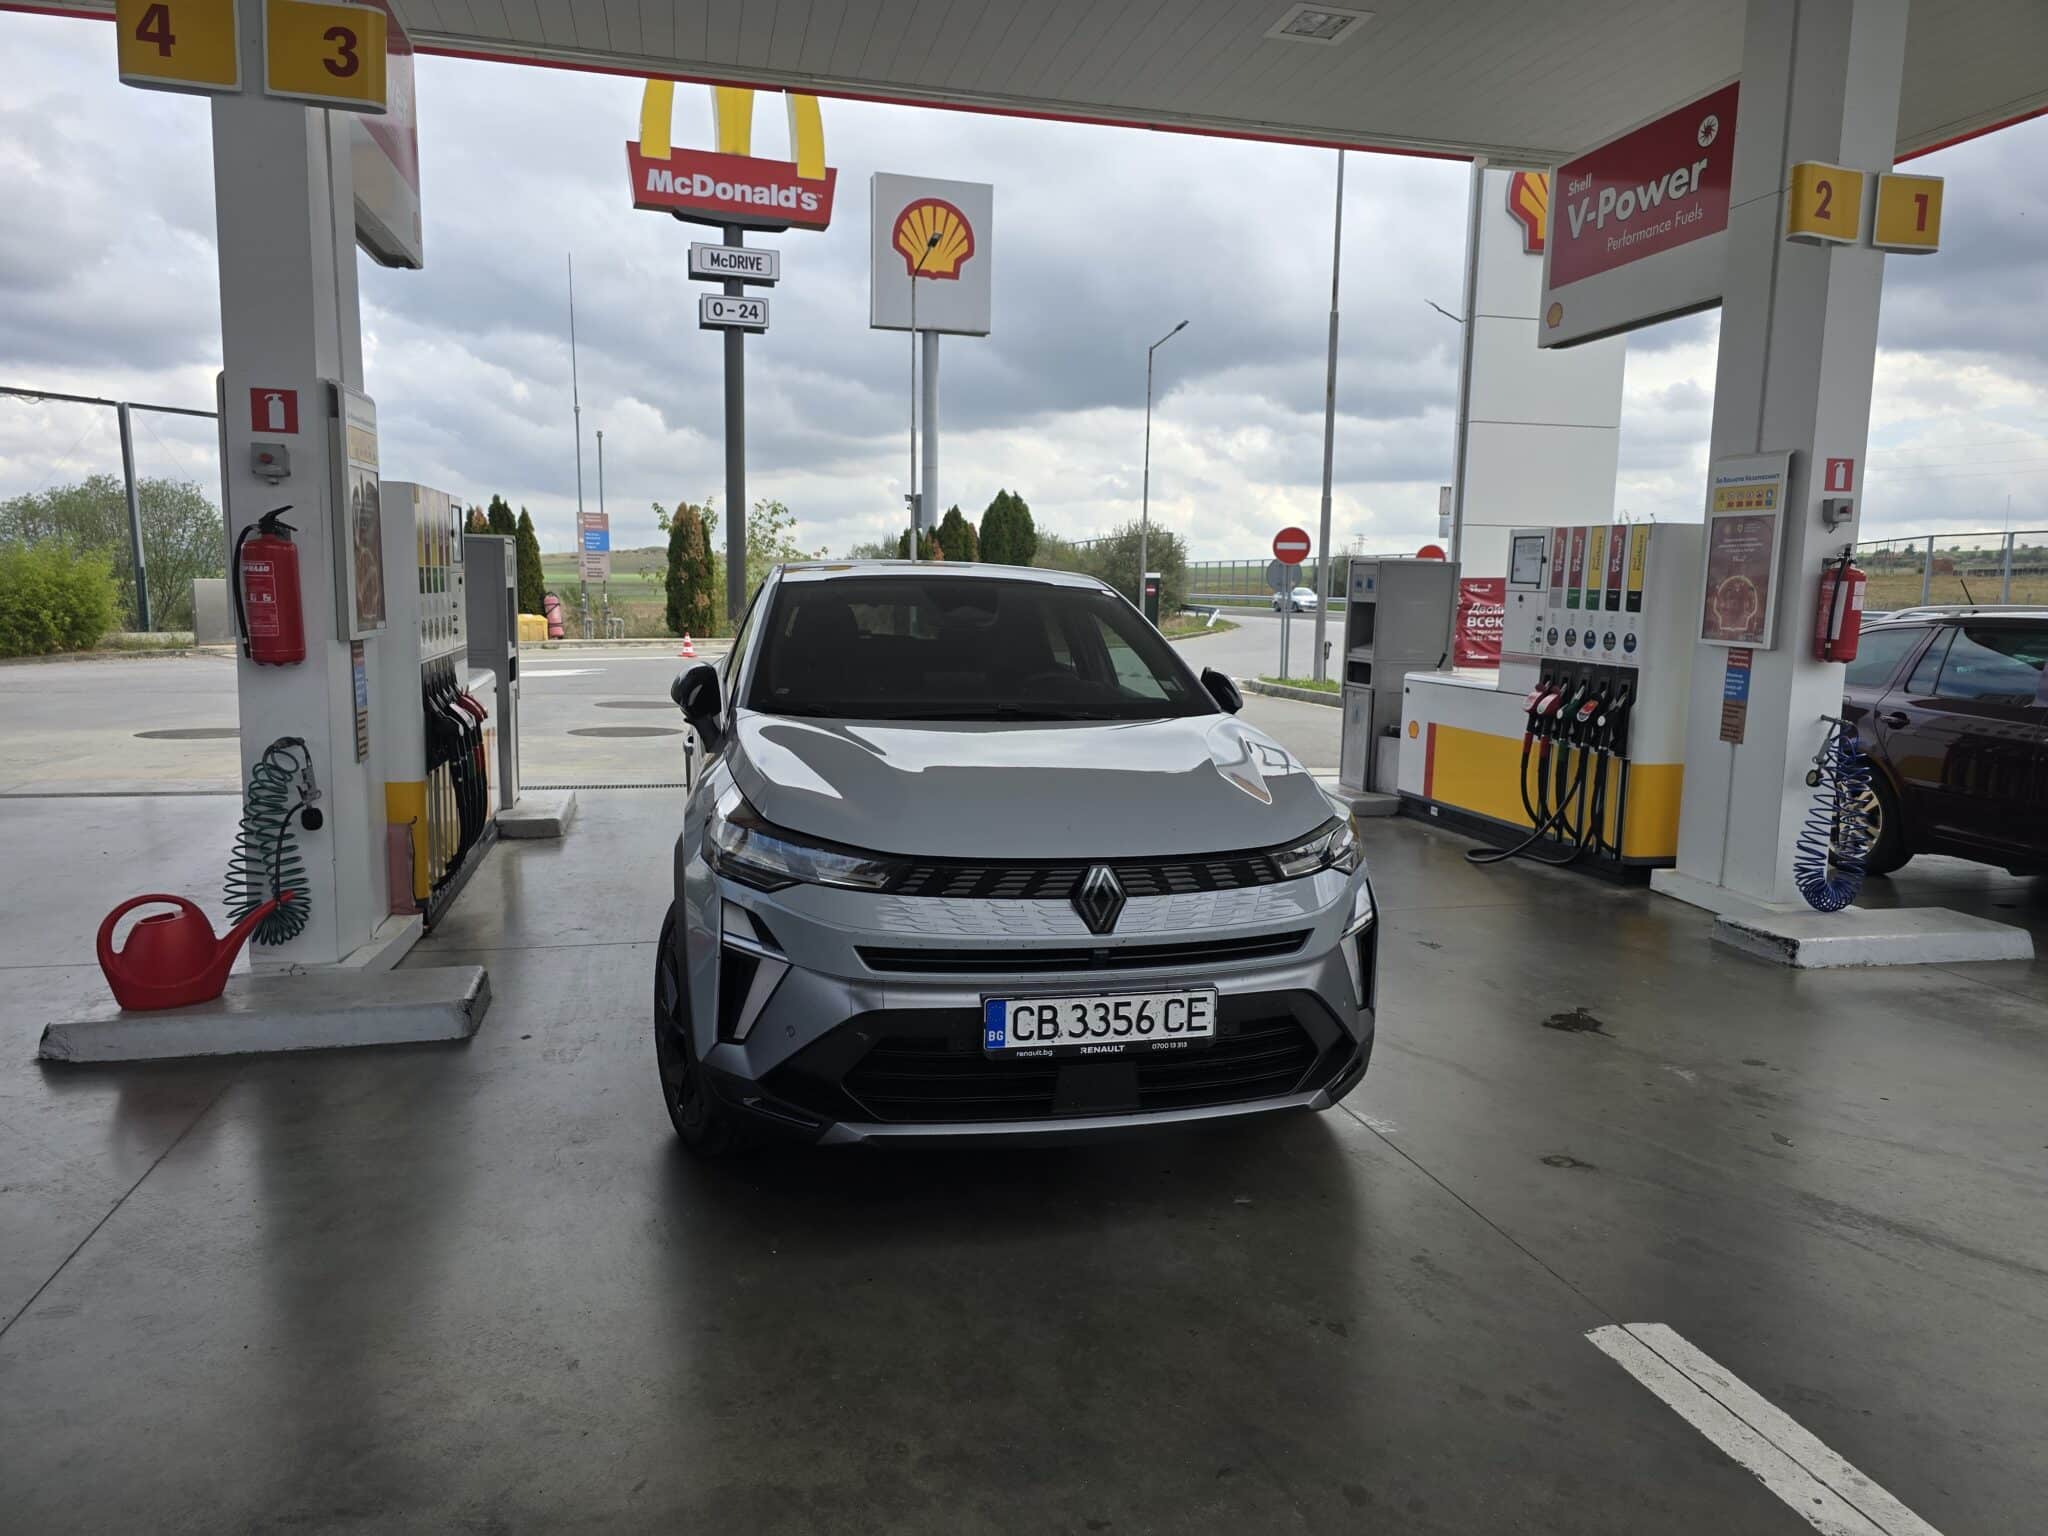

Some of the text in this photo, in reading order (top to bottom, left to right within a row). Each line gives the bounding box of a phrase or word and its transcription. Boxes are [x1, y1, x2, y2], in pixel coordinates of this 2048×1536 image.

[136, 3, 176, 57] 4
[323, 26, 359, 78] 3
[646, 168, 818, 212] McDonald's
[1567, 172, 1592, 197] Shell
[1567, 157, 1708, 239] V-Power
[1814, 179, 1832, 220] 2
[1606, 201, 1704, 252] Performance Fuels
[1913, 193, 1929, 232] 1
[709, 250, 764, 272] McDRIVE
[988, 1030, 1004, 1042] BG
[1012, 996, 1208, 1041] CB 3356 CE
[1016, 1049, 1053, 1058] renault.bg
[1080, 1044, 1125, 1055] RENAULT
